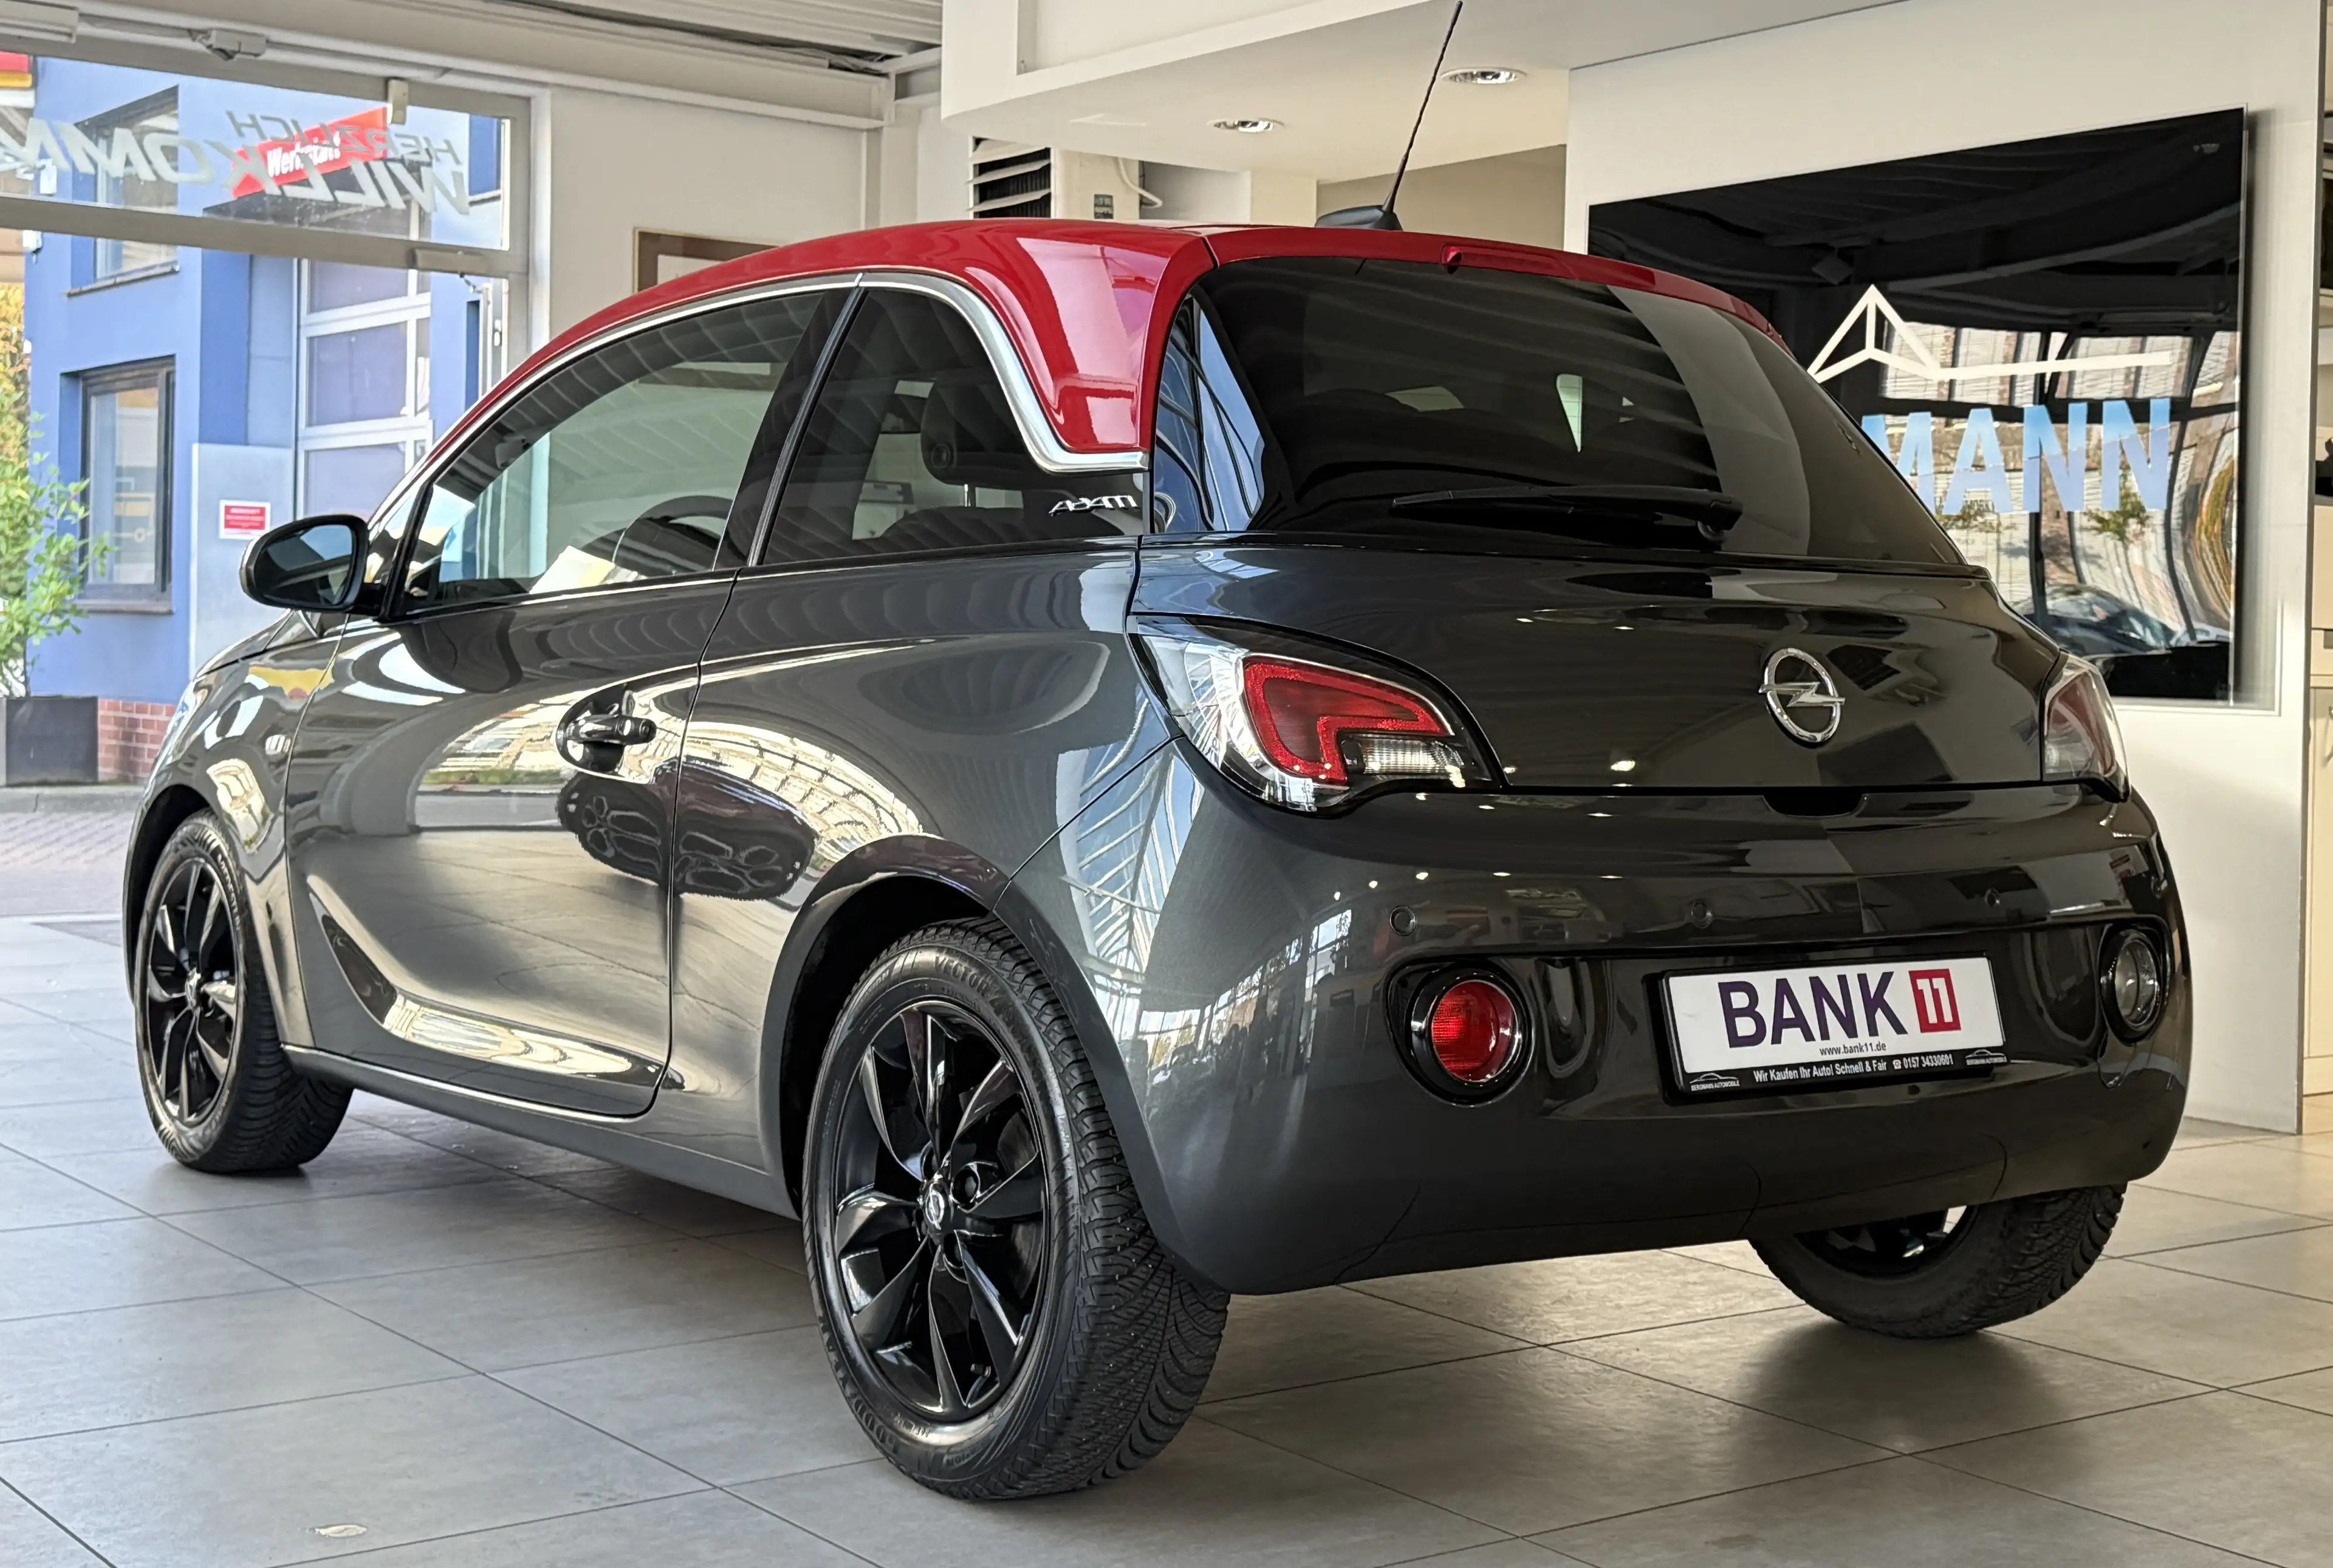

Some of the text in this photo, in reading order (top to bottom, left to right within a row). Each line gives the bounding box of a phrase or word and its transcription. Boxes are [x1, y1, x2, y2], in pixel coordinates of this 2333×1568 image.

[1718, 971, 1953, 1049] BANK 11
[1819, 1041, 1886, 1056] www.bank11.de
[1753, 1070, 1768, 1083] Wir
[1769, 1067, 1799, 1081] Kaufen
[1800, 1066, 1811, 1079] Ihr
[1812, 1064, 1834, 1077] Auto!
[1835, 1061, 1863, 1075] Schnell
[1865, 1060, 1872, 1072] &
[1872, 1059, 1887, 1072] Fair
[1903, 1056, 1920, 1069] 0157
